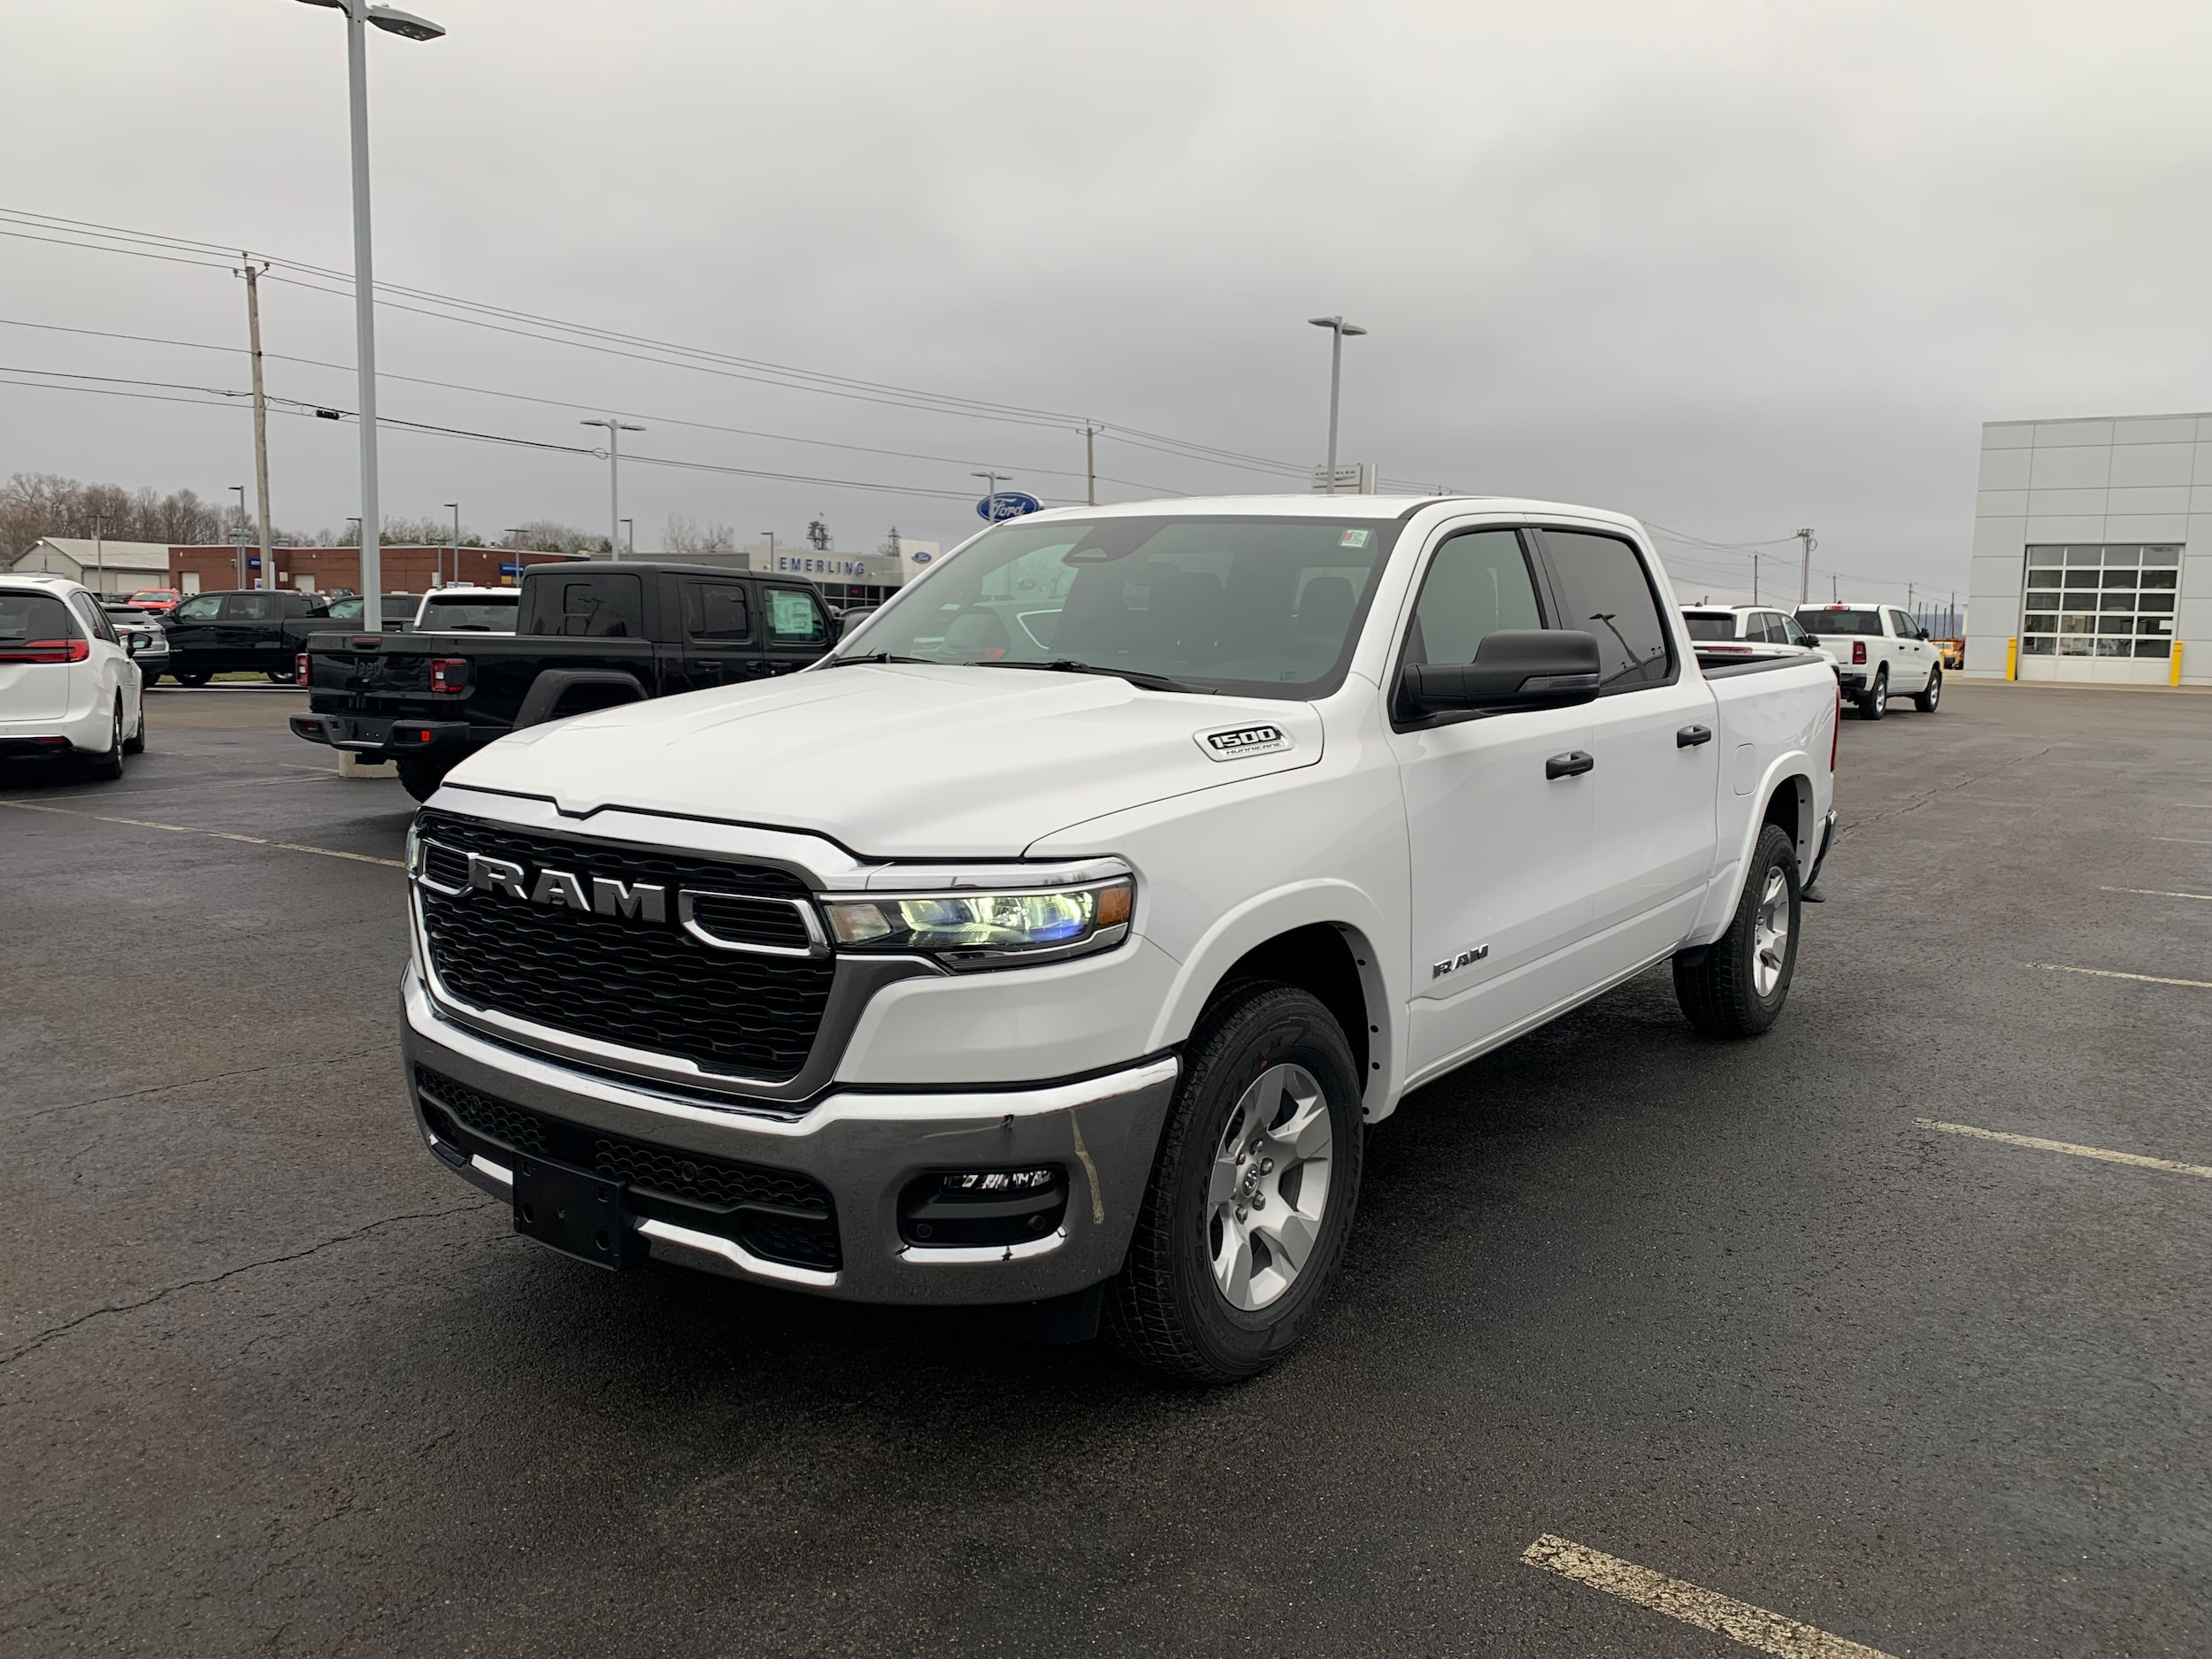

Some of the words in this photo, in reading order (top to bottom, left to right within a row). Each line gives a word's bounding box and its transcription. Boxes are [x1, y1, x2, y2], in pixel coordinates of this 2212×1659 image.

[988, 497, 1026, 518] Ford
[780, 557, 864, 575] EMERLING
[350, 657, 382, 677] Jeep
[1209, 728, 1276, 749] 1500
[468, 853, 665, 923] RAM
[1432, 943, 1488, 979] RAM
